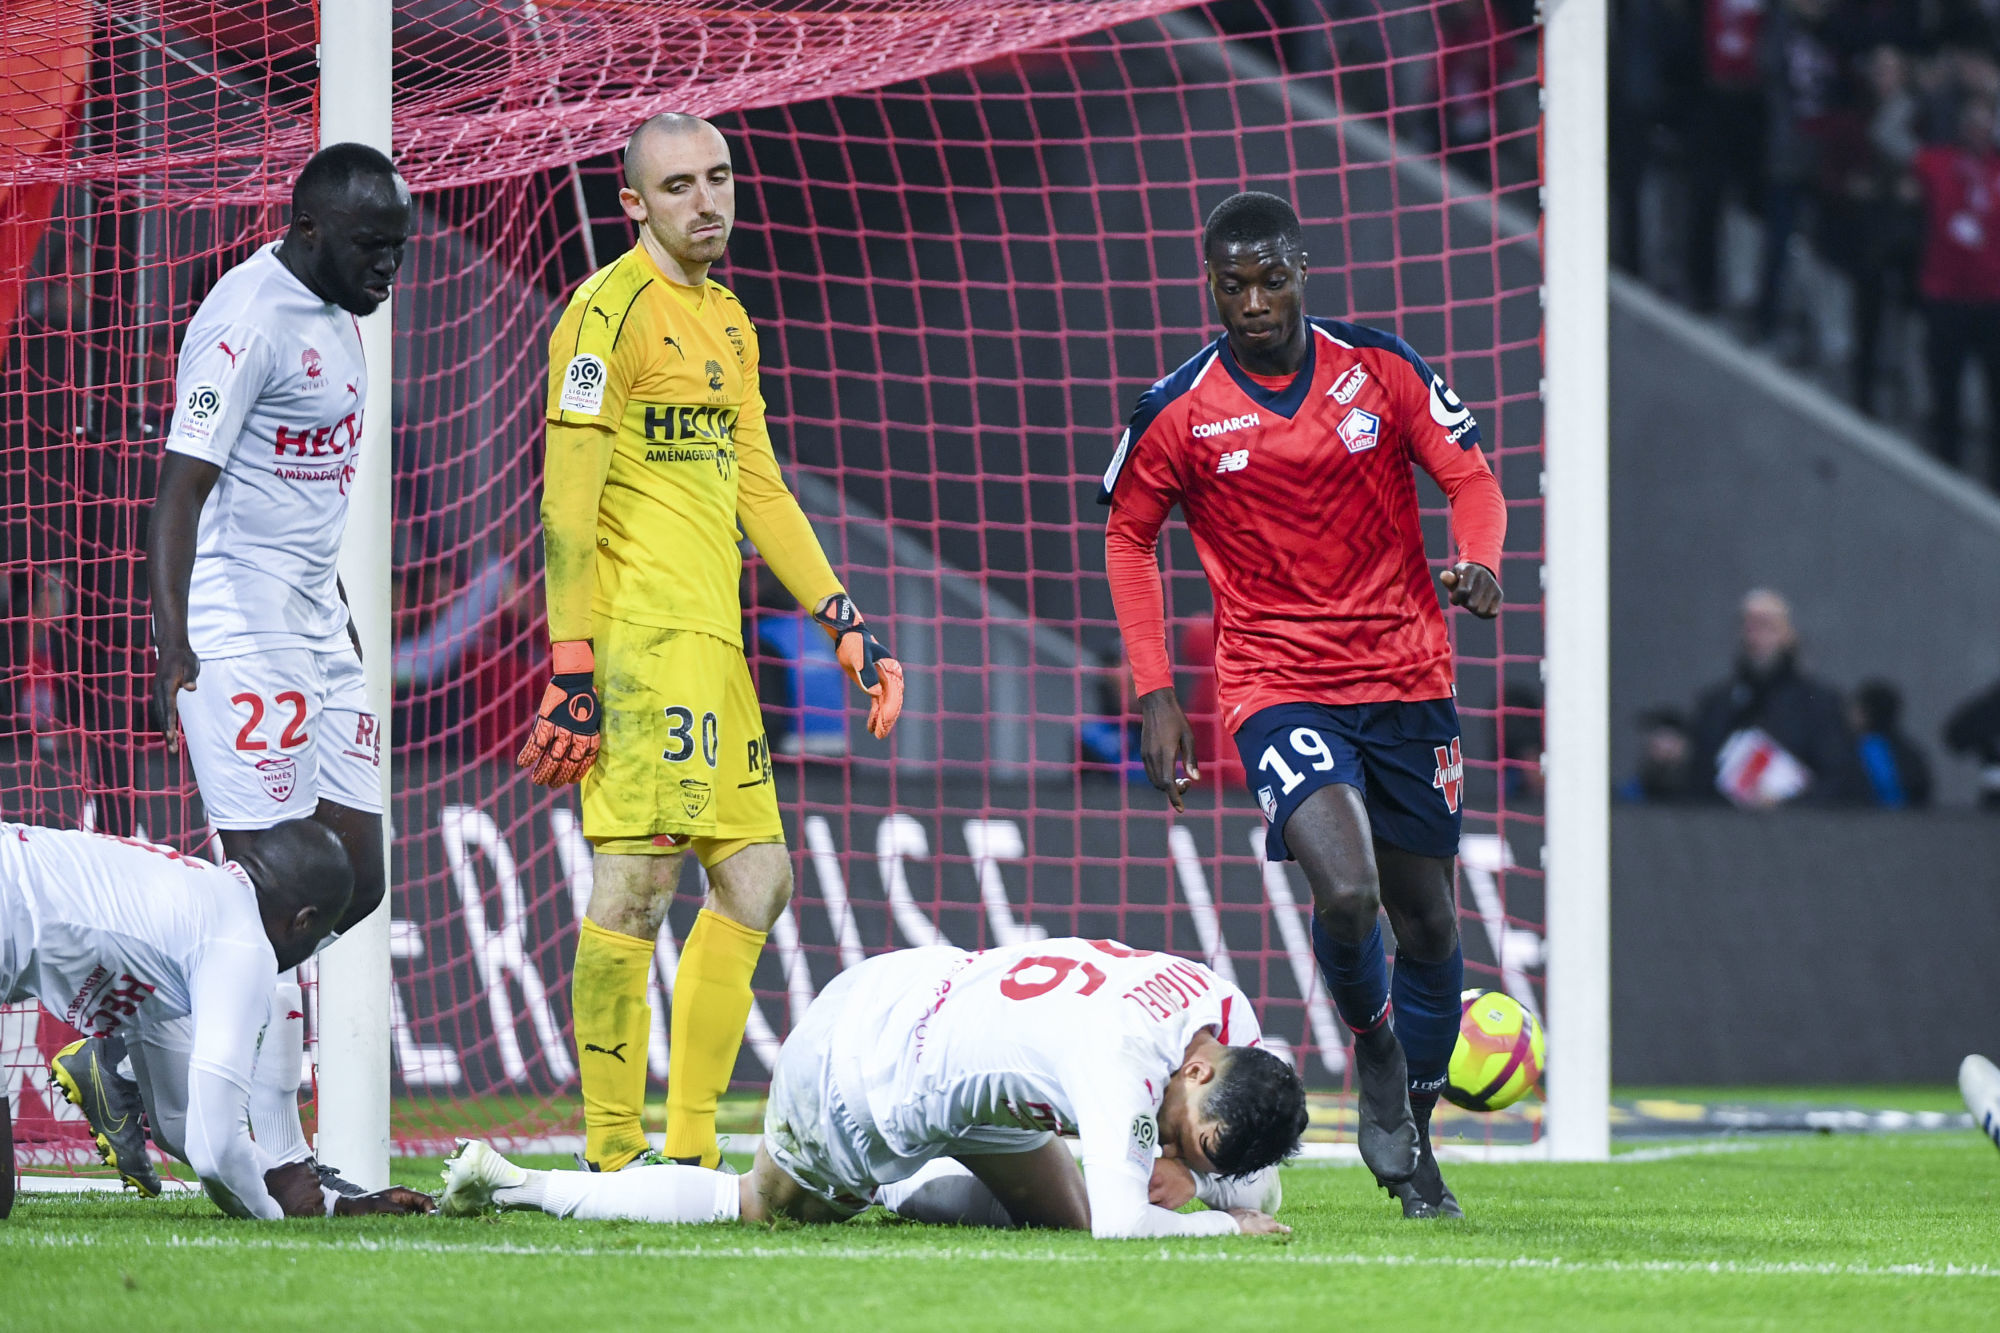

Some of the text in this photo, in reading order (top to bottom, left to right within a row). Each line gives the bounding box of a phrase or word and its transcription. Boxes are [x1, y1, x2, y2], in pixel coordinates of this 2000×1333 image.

[564, 393, 599, 406] Conforama
[569, 388, 594, 398] LIGUE
[1333, 366, 1368, 404] DMAX
[1191, 412, 1261, 438] COMARCH
[1349, 436, 1374, 451] LOSC
[230, 690, 308, 751] 22
[662, 705, 718, 769] 30
[1258, 726, 1335, 797] 19
[1122, 960, 1211, 1022] MIGUEL
